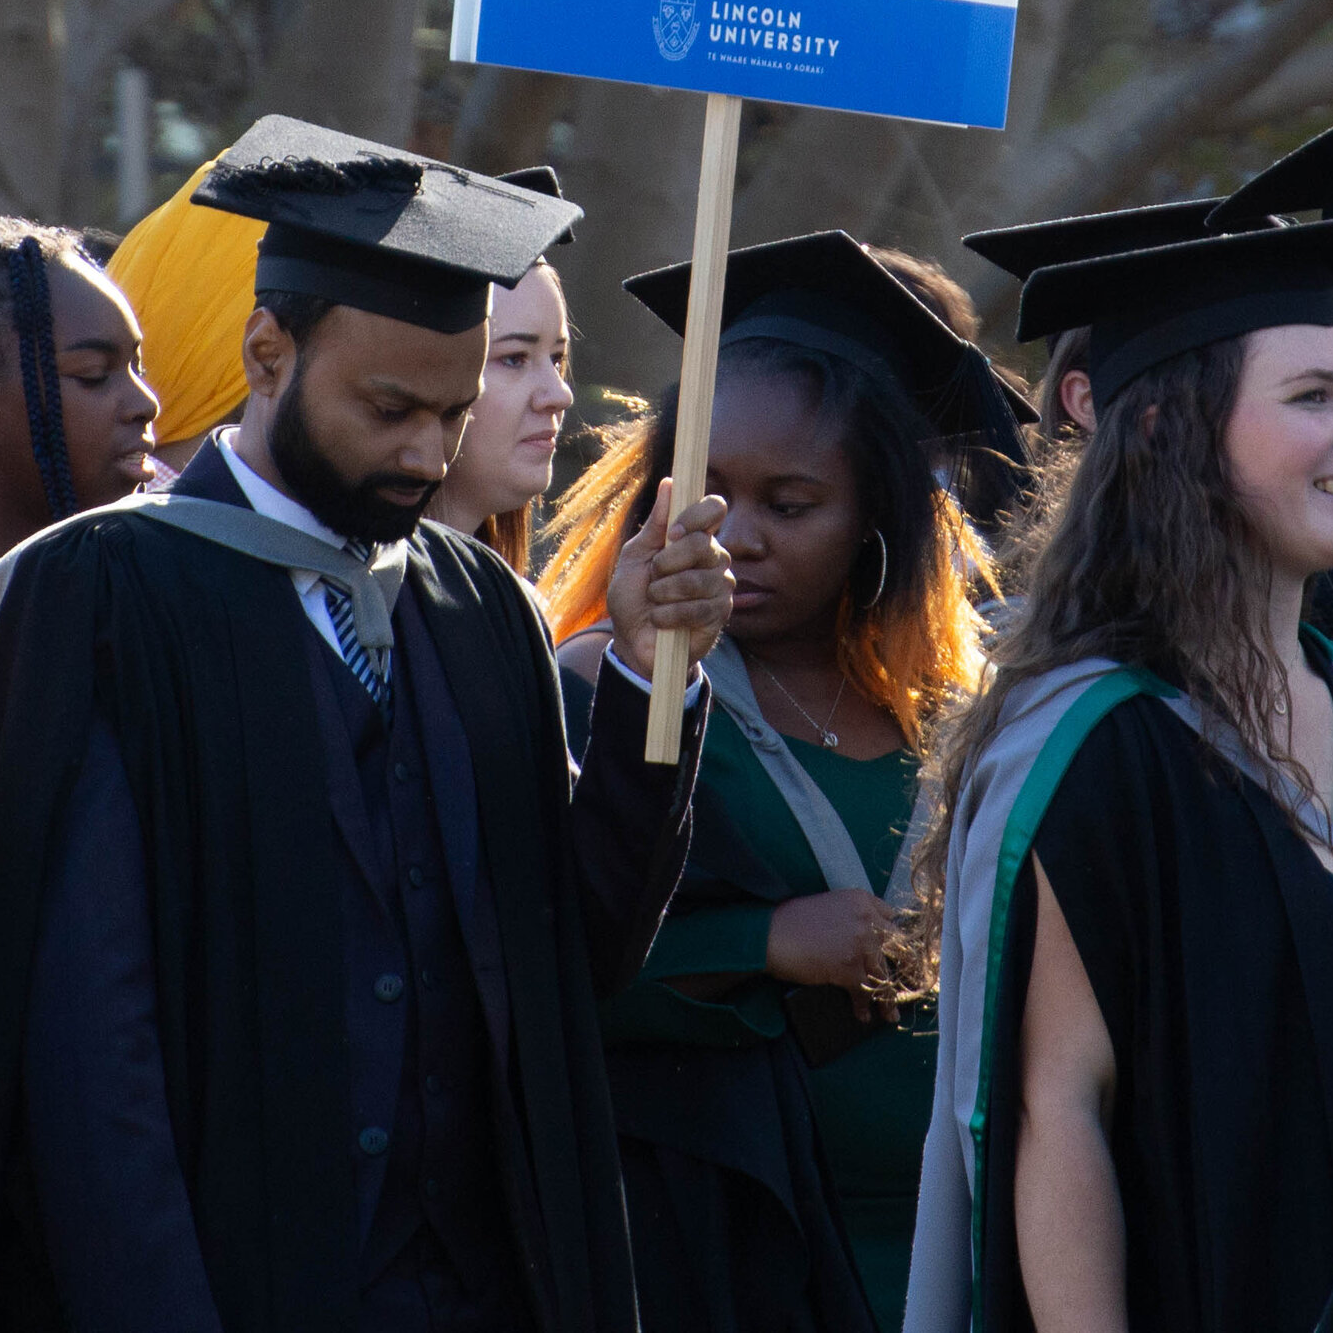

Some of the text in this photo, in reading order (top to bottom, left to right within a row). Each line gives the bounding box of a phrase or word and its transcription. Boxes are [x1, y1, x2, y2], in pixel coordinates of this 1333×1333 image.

[711, 1, 801, 29] LINCOLN
[709, 24, 839, 57] UNIVERSITY
[708, 51, 717, 61] TE
[720, 54, 747, 65] WHARE
[785, 62, 792, 71] O
